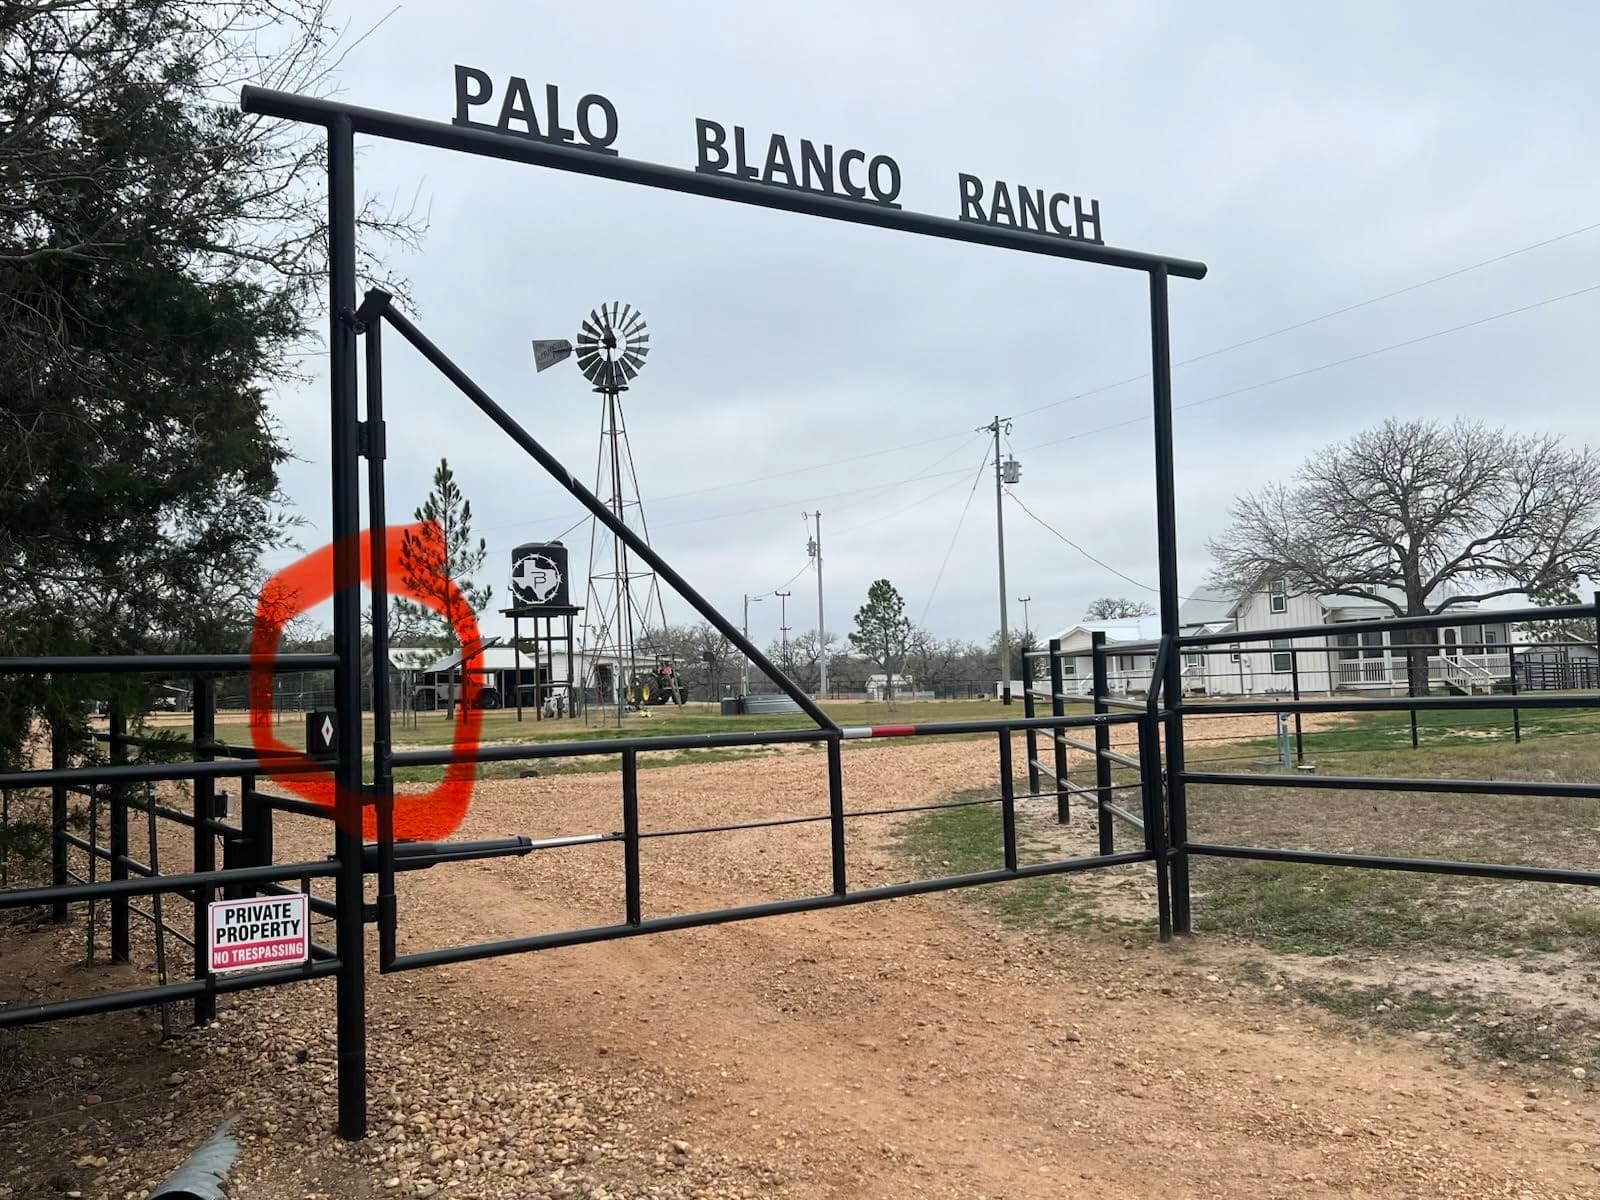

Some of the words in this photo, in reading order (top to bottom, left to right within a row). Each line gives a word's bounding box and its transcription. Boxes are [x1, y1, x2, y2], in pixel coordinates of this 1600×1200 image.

[453, 64, 619, 156] PALO
[695, 117, 902, 209] BLANCO
[958, 172, 1104, 246] RANCH
[225, 902, 292, 925] PRIVATE
[216, 919, 300, 944] PROPERTY
[213, 951, 229, 965] NO
[232, 942, 303, 963] TRESPASSING
